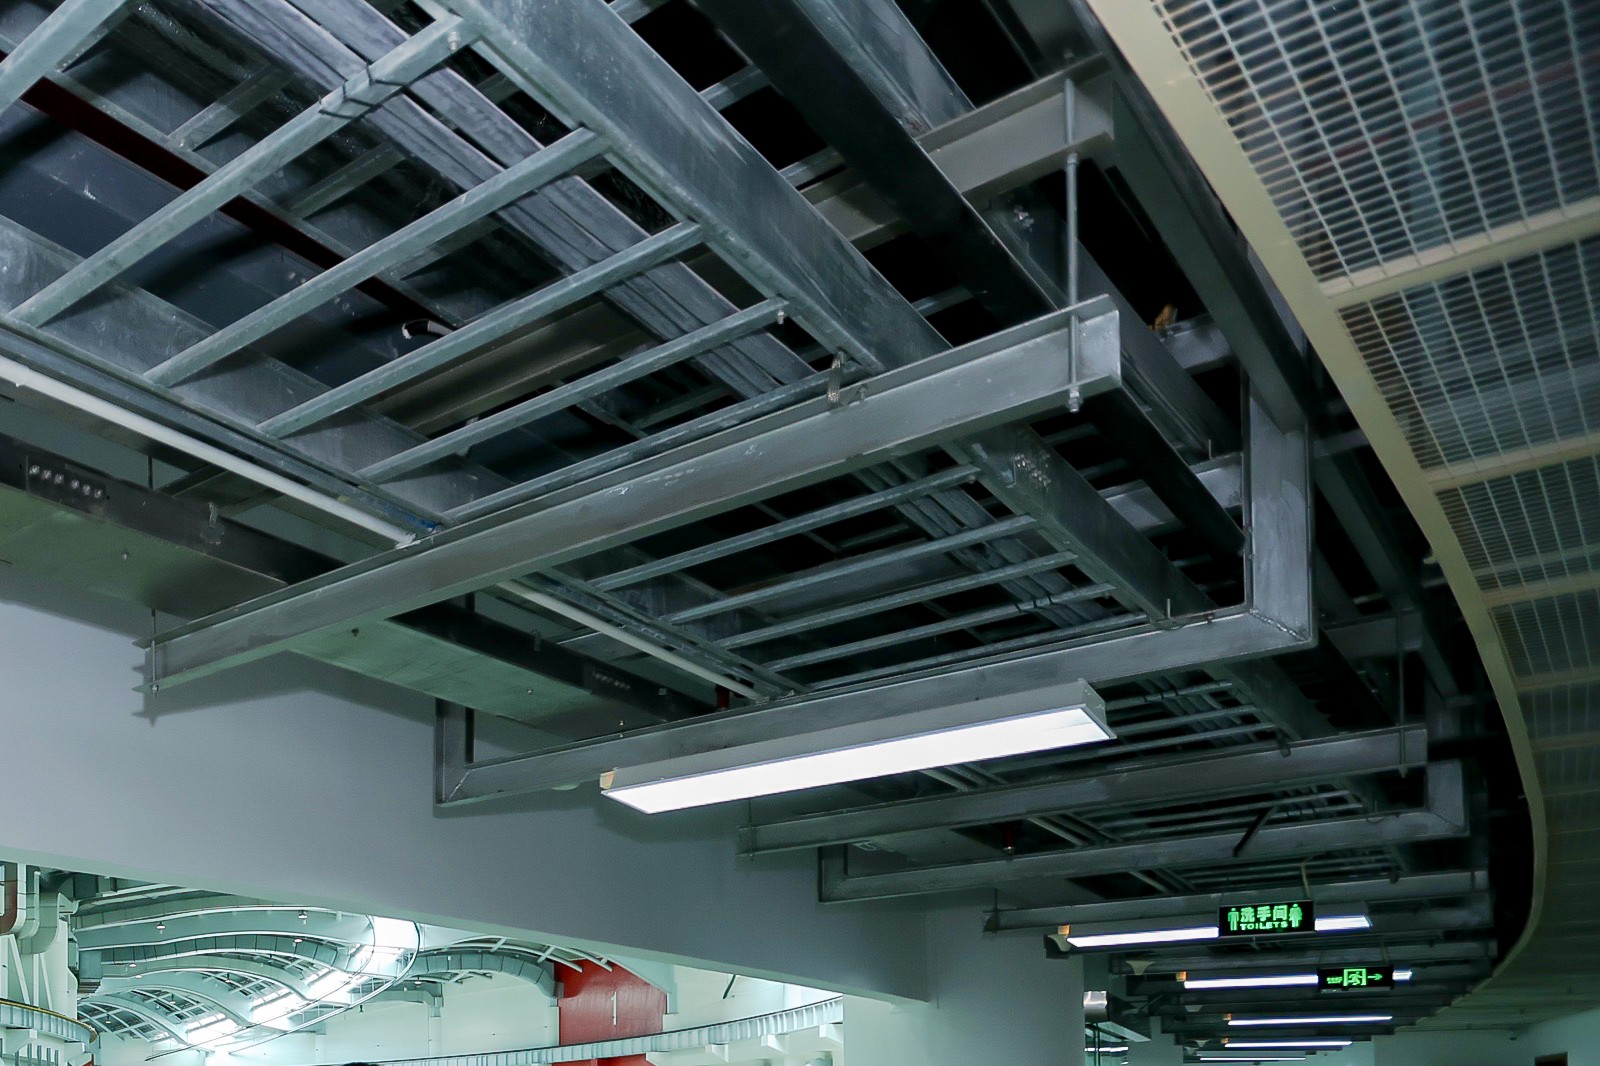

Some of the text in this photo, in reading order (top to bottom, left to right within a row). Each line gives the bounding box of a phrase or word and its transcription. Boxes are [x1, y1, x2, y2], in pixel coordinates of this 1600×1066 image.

[1240, 905, 1288, 922] 洗手间
[1240, 921, 1288, 931] TOILETS
[610, 991, 617, 1026] 1
